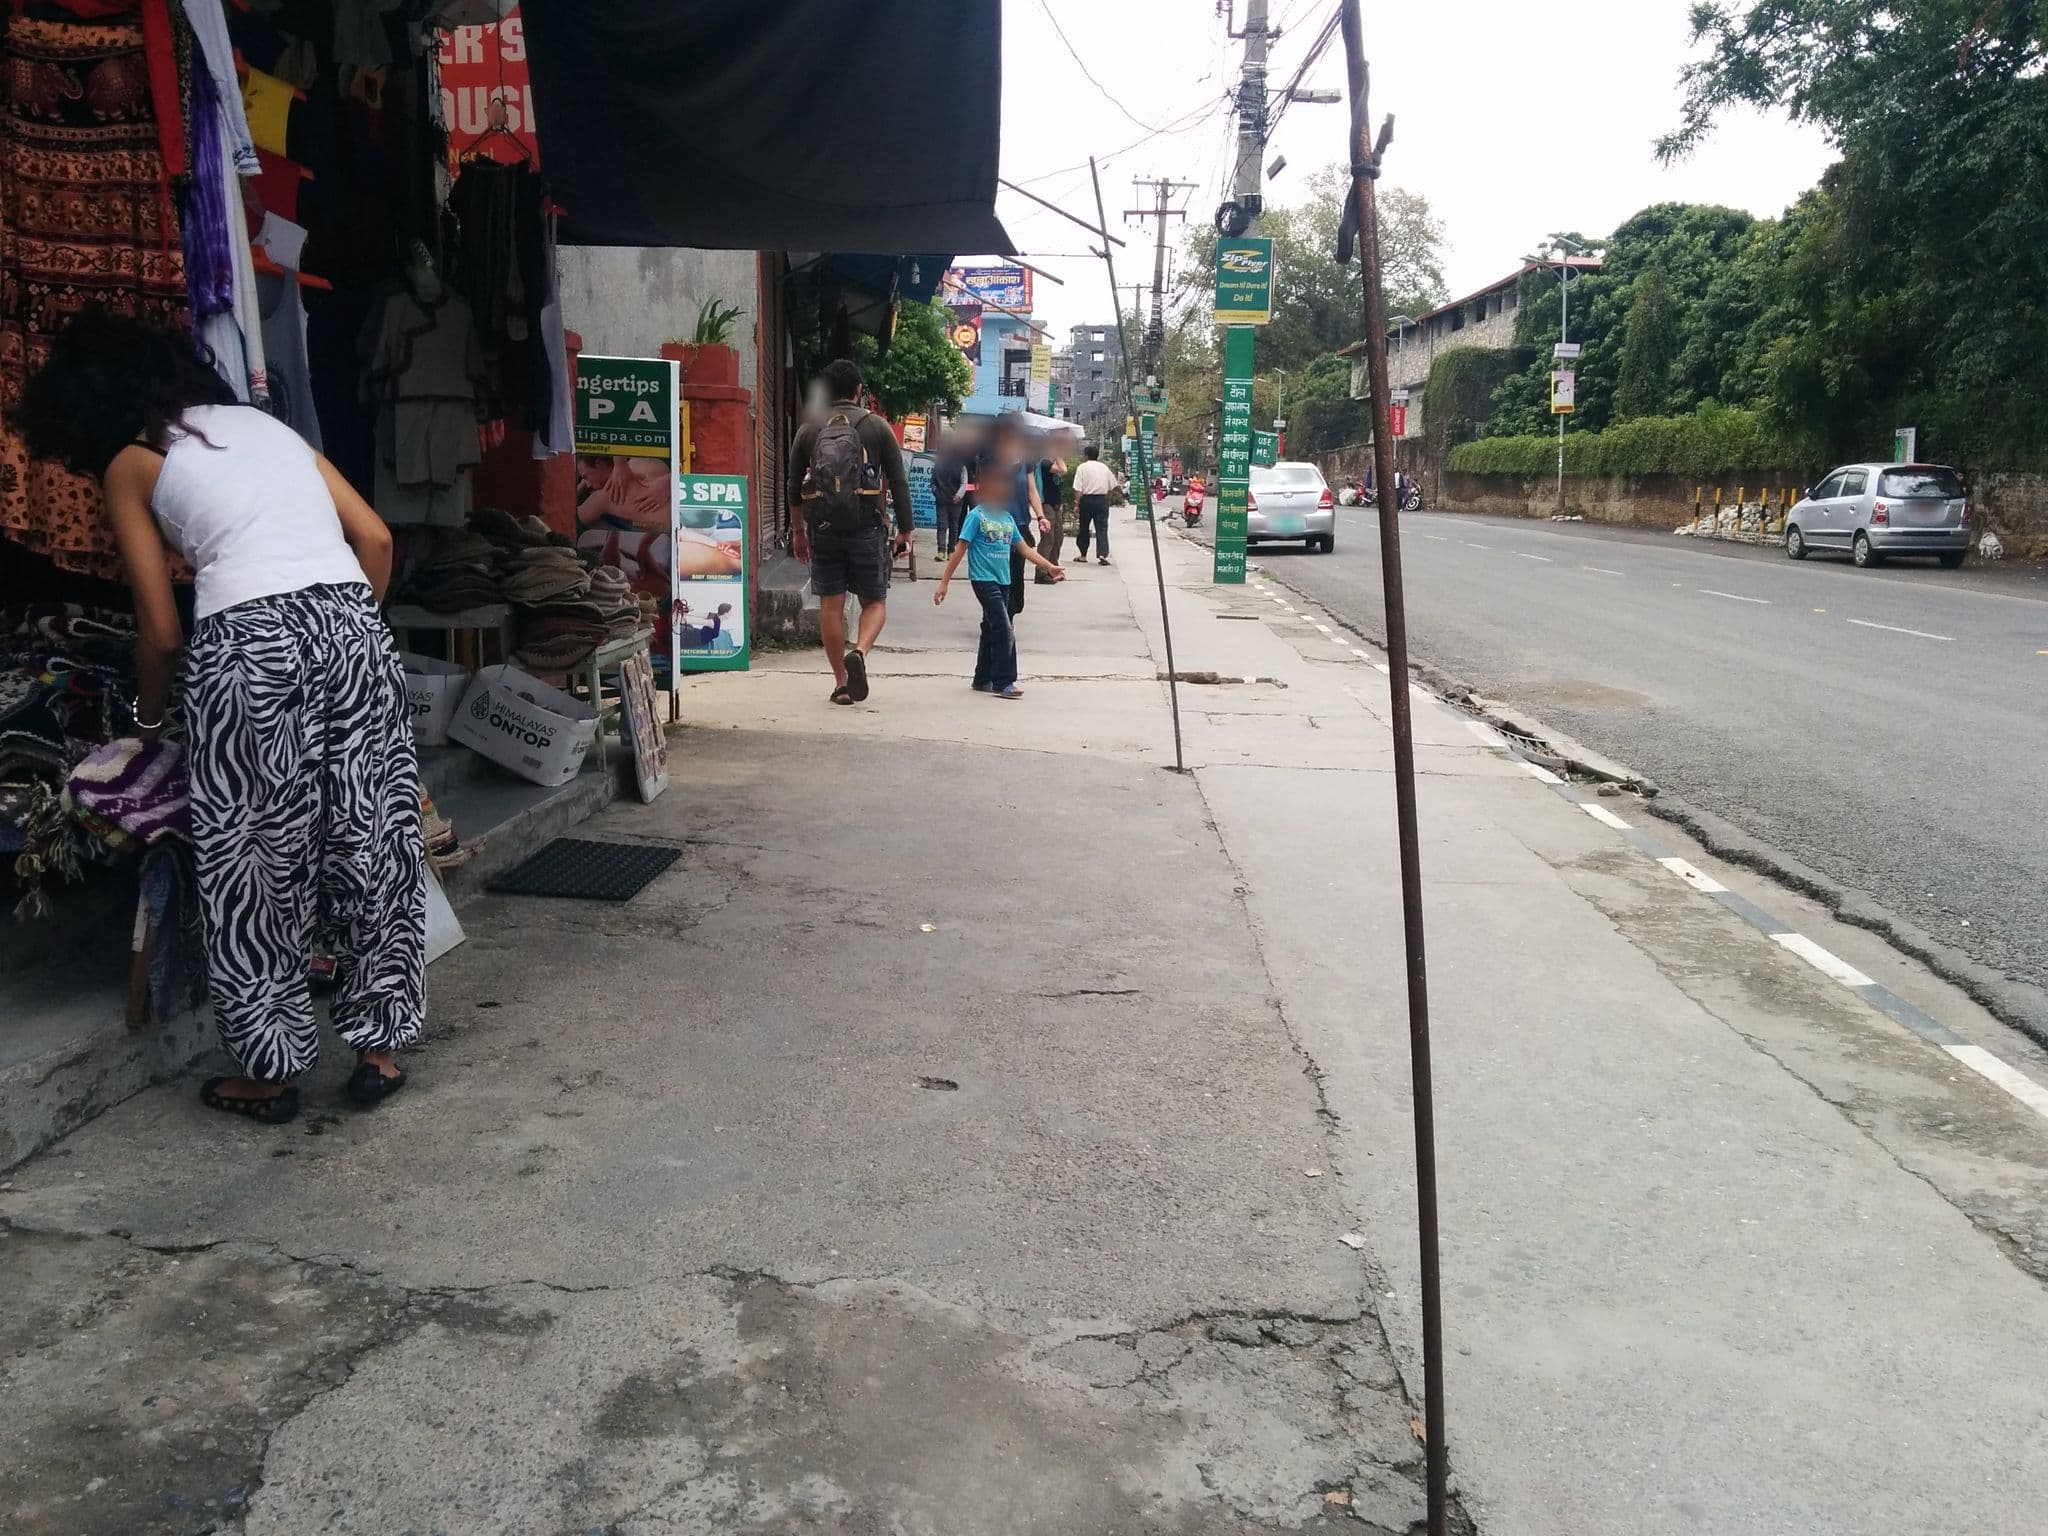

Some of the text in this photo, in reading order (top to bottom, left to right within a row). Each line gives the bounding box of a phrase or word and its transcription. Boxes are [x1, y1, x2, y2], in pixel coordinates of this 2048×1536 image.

[577, 374, 660, 397] ngertips
[1258, 437, 1272, 447] USE
[693, 483, 742, 502] SPA
[495, 702, 557, 737] HIMALAYAS'
[490, 714, 551, 749] ONTOP
